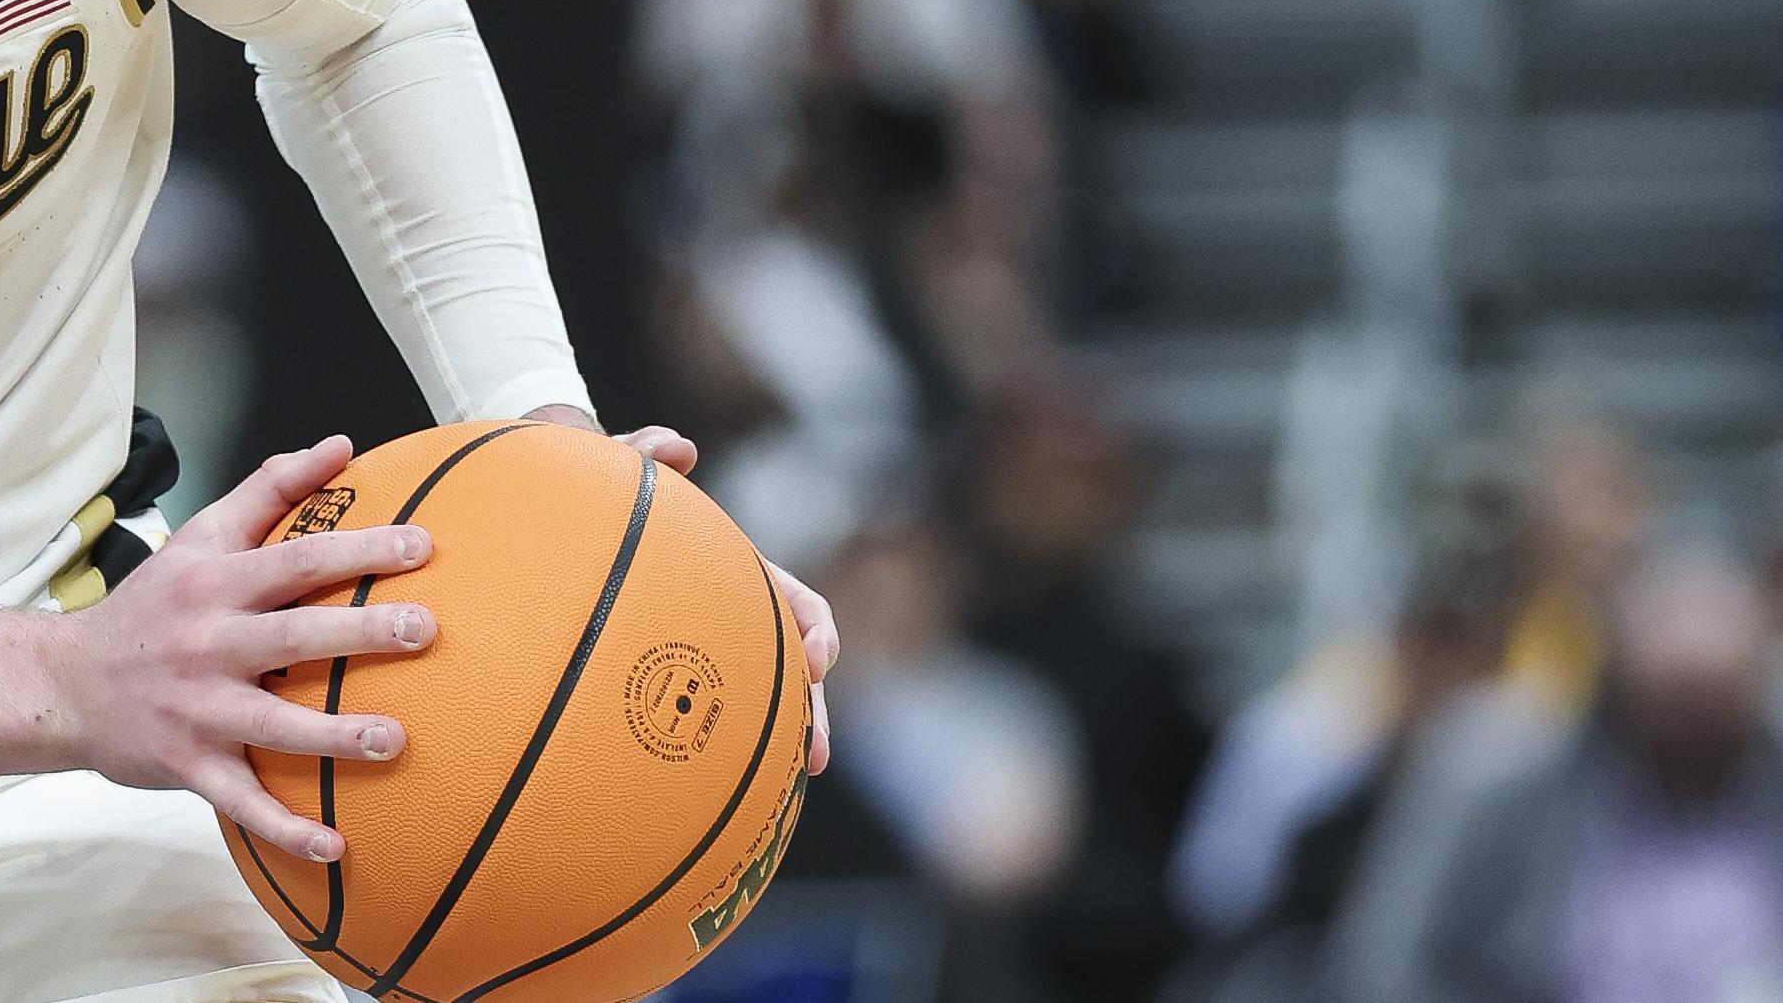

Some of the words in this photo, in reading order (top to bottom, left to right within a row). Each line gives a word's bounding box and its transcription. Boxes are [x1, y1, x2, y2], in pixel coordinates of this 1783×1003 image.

[696, 738, 703, 748] 7
[702, 703, 719, 735] SIZE
[688, 726, 813, 953] CAA
[746, 788, 786, 858] GAME
[688, 861, 743, 912] BALL
